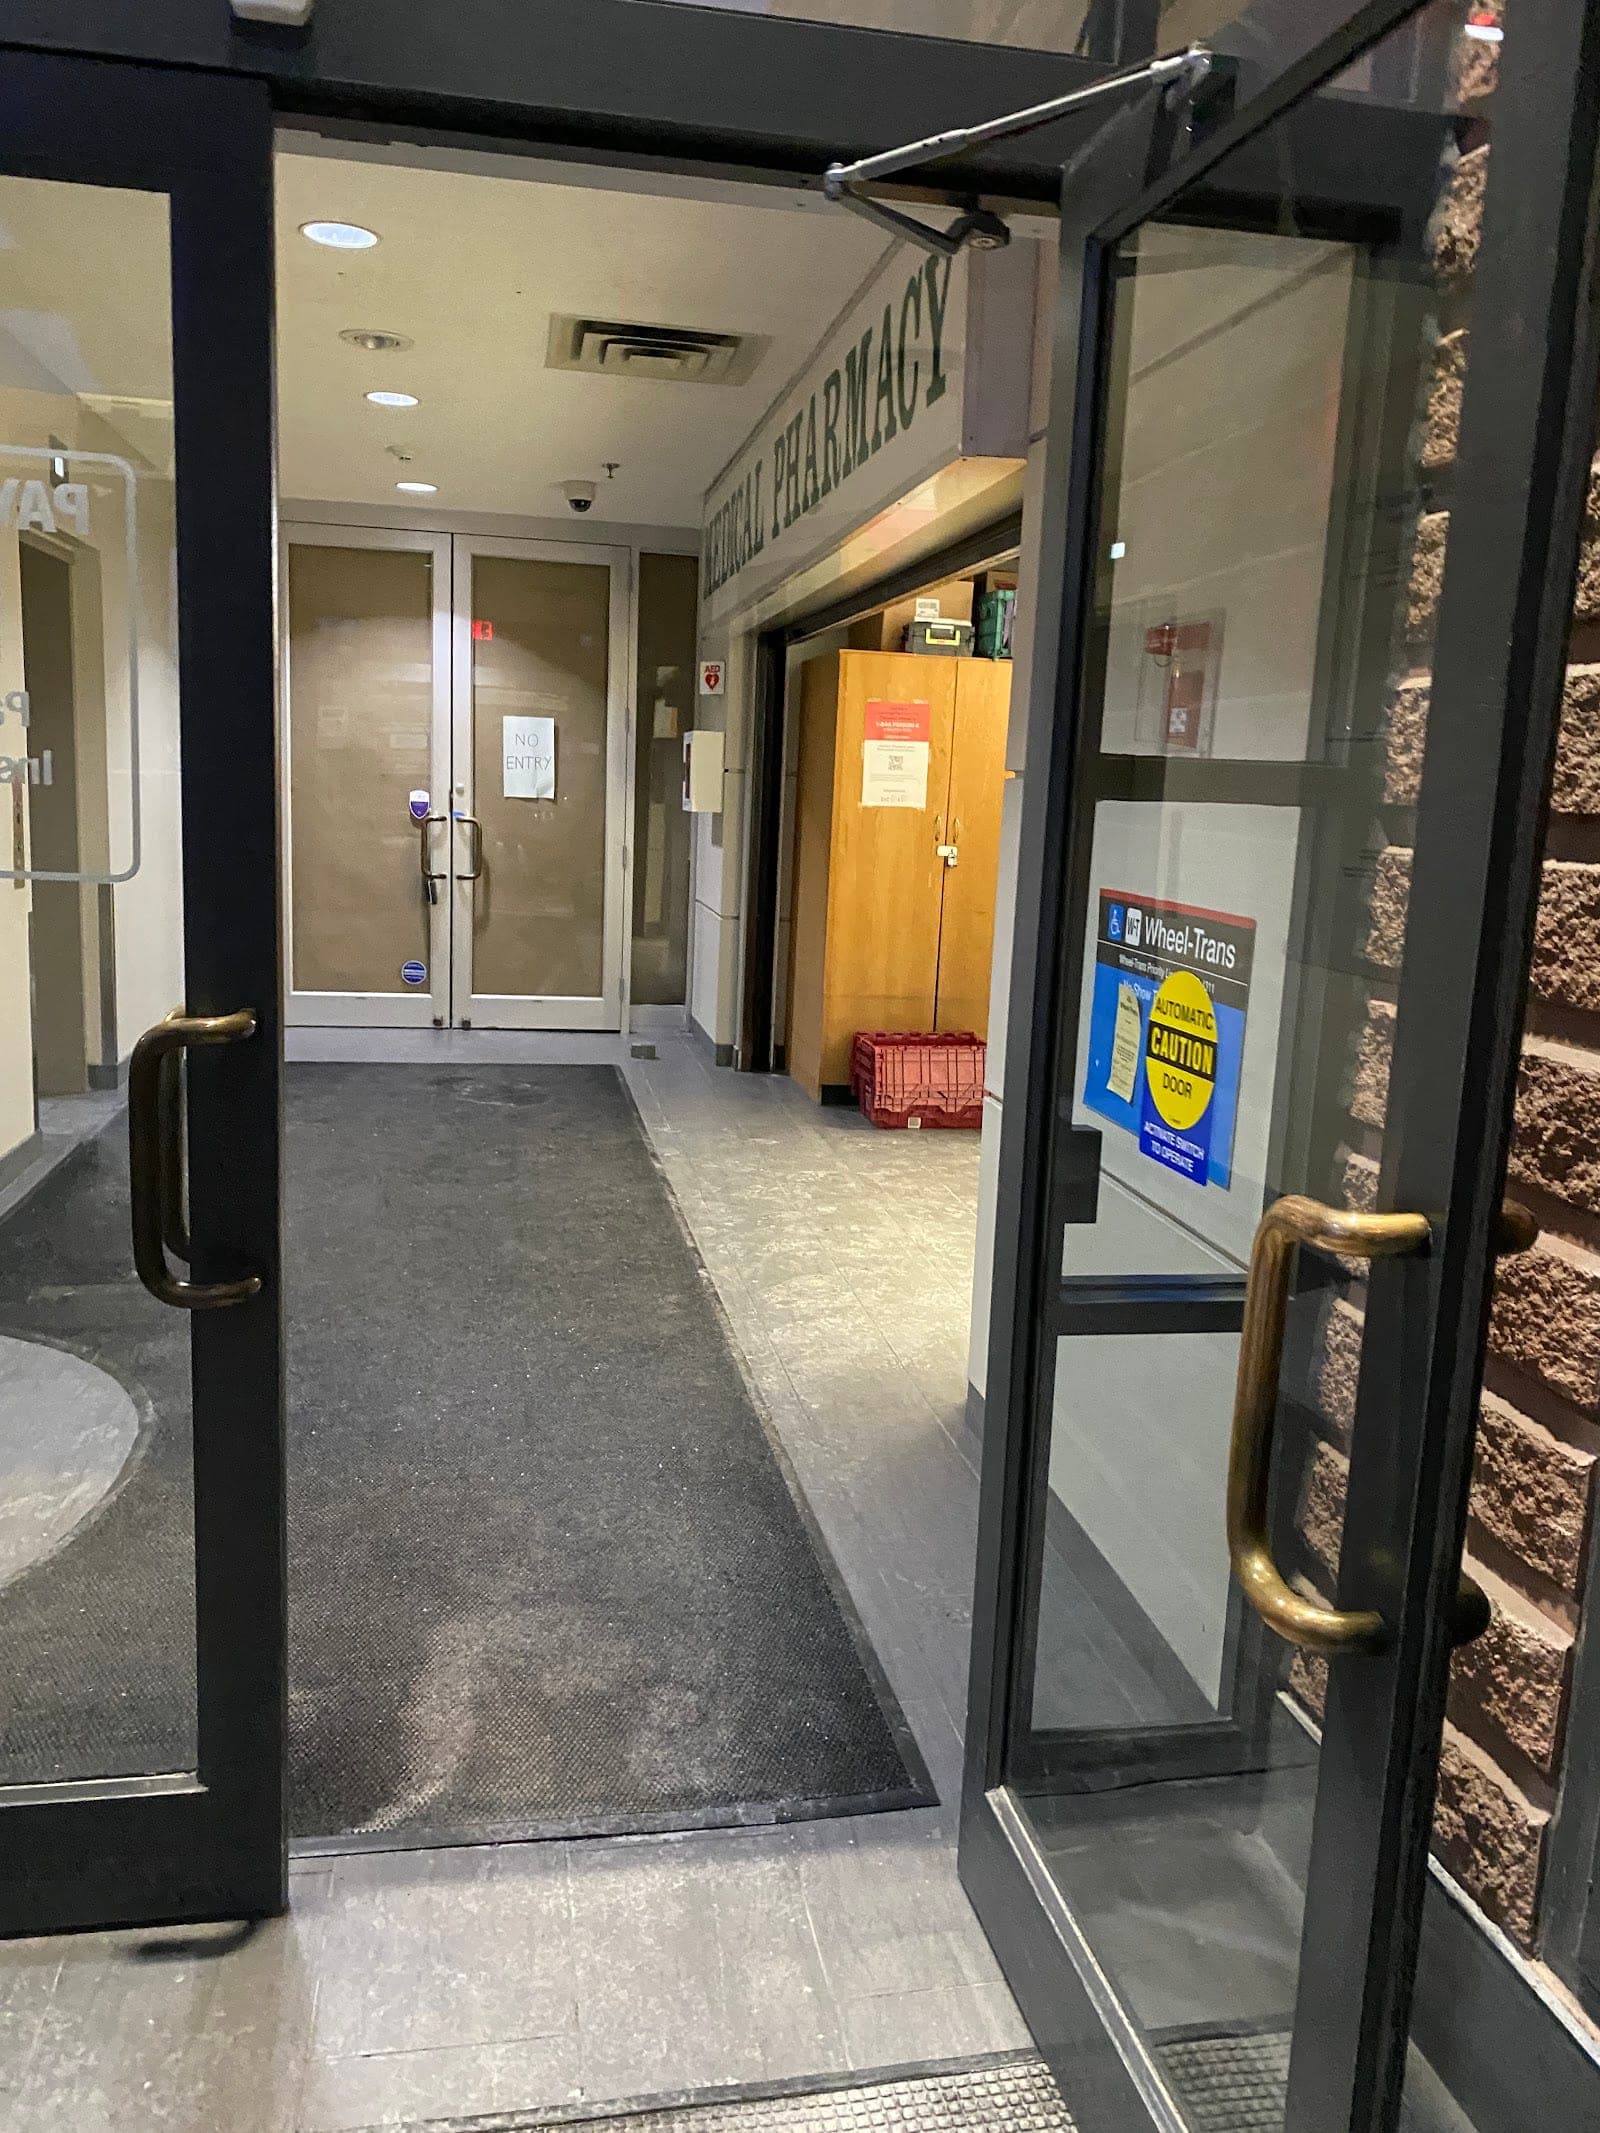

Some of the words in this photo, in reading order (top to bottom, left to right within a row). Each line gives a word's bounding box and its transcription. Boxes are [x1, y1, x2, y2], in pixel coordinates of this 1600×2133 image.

[772, 253, 952, 539] PHARMACY
[704, 665, 721, 674] AED
[515, 733, 539, 748] NO
[506, 755, 552, 770] ENTRY
[1144, 915, 1237, 969] Wheel-Trans
[1156, 997, 1215, 1031] AUTOMATIC
[1151, 1026, 1213, 1076] CAUTION
[1162, 1073, 1193, 1099] DOOR
[1143, 1120, 1176, 1146] ACTIVATE
[1176, 1136, 1206, 1161] SWITCH
[1151, 1140, 1161, 1155] TO
[1161, 1145, 1195, 1174] OPERATE
